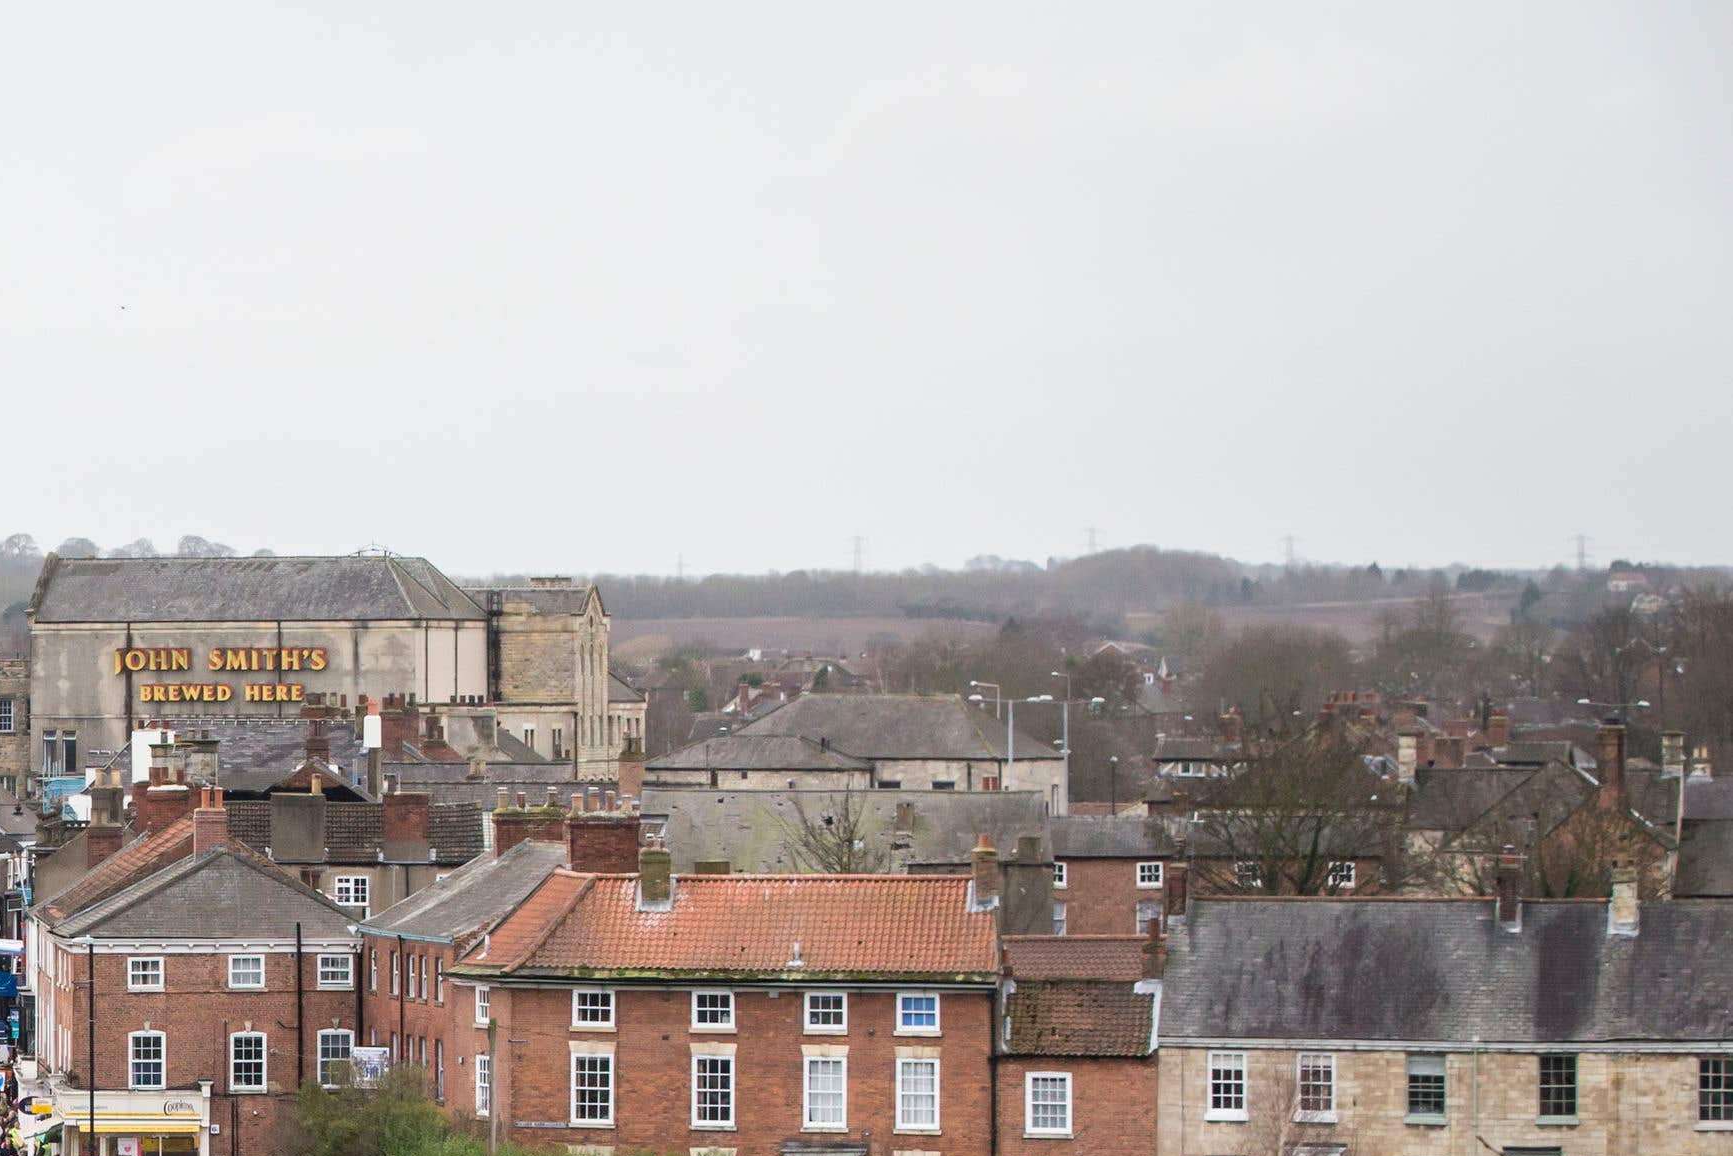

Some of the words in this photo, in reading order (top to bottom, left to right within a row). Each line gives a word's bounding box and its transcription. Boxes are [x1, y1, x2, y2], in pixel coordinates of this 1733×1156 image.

[114, 647, 191, 676] JOHN
[208, 647, 329, 672] SMITH'S
[140, 683, 233, 703] BREWED
[245, 683, 304, 703] HERE
